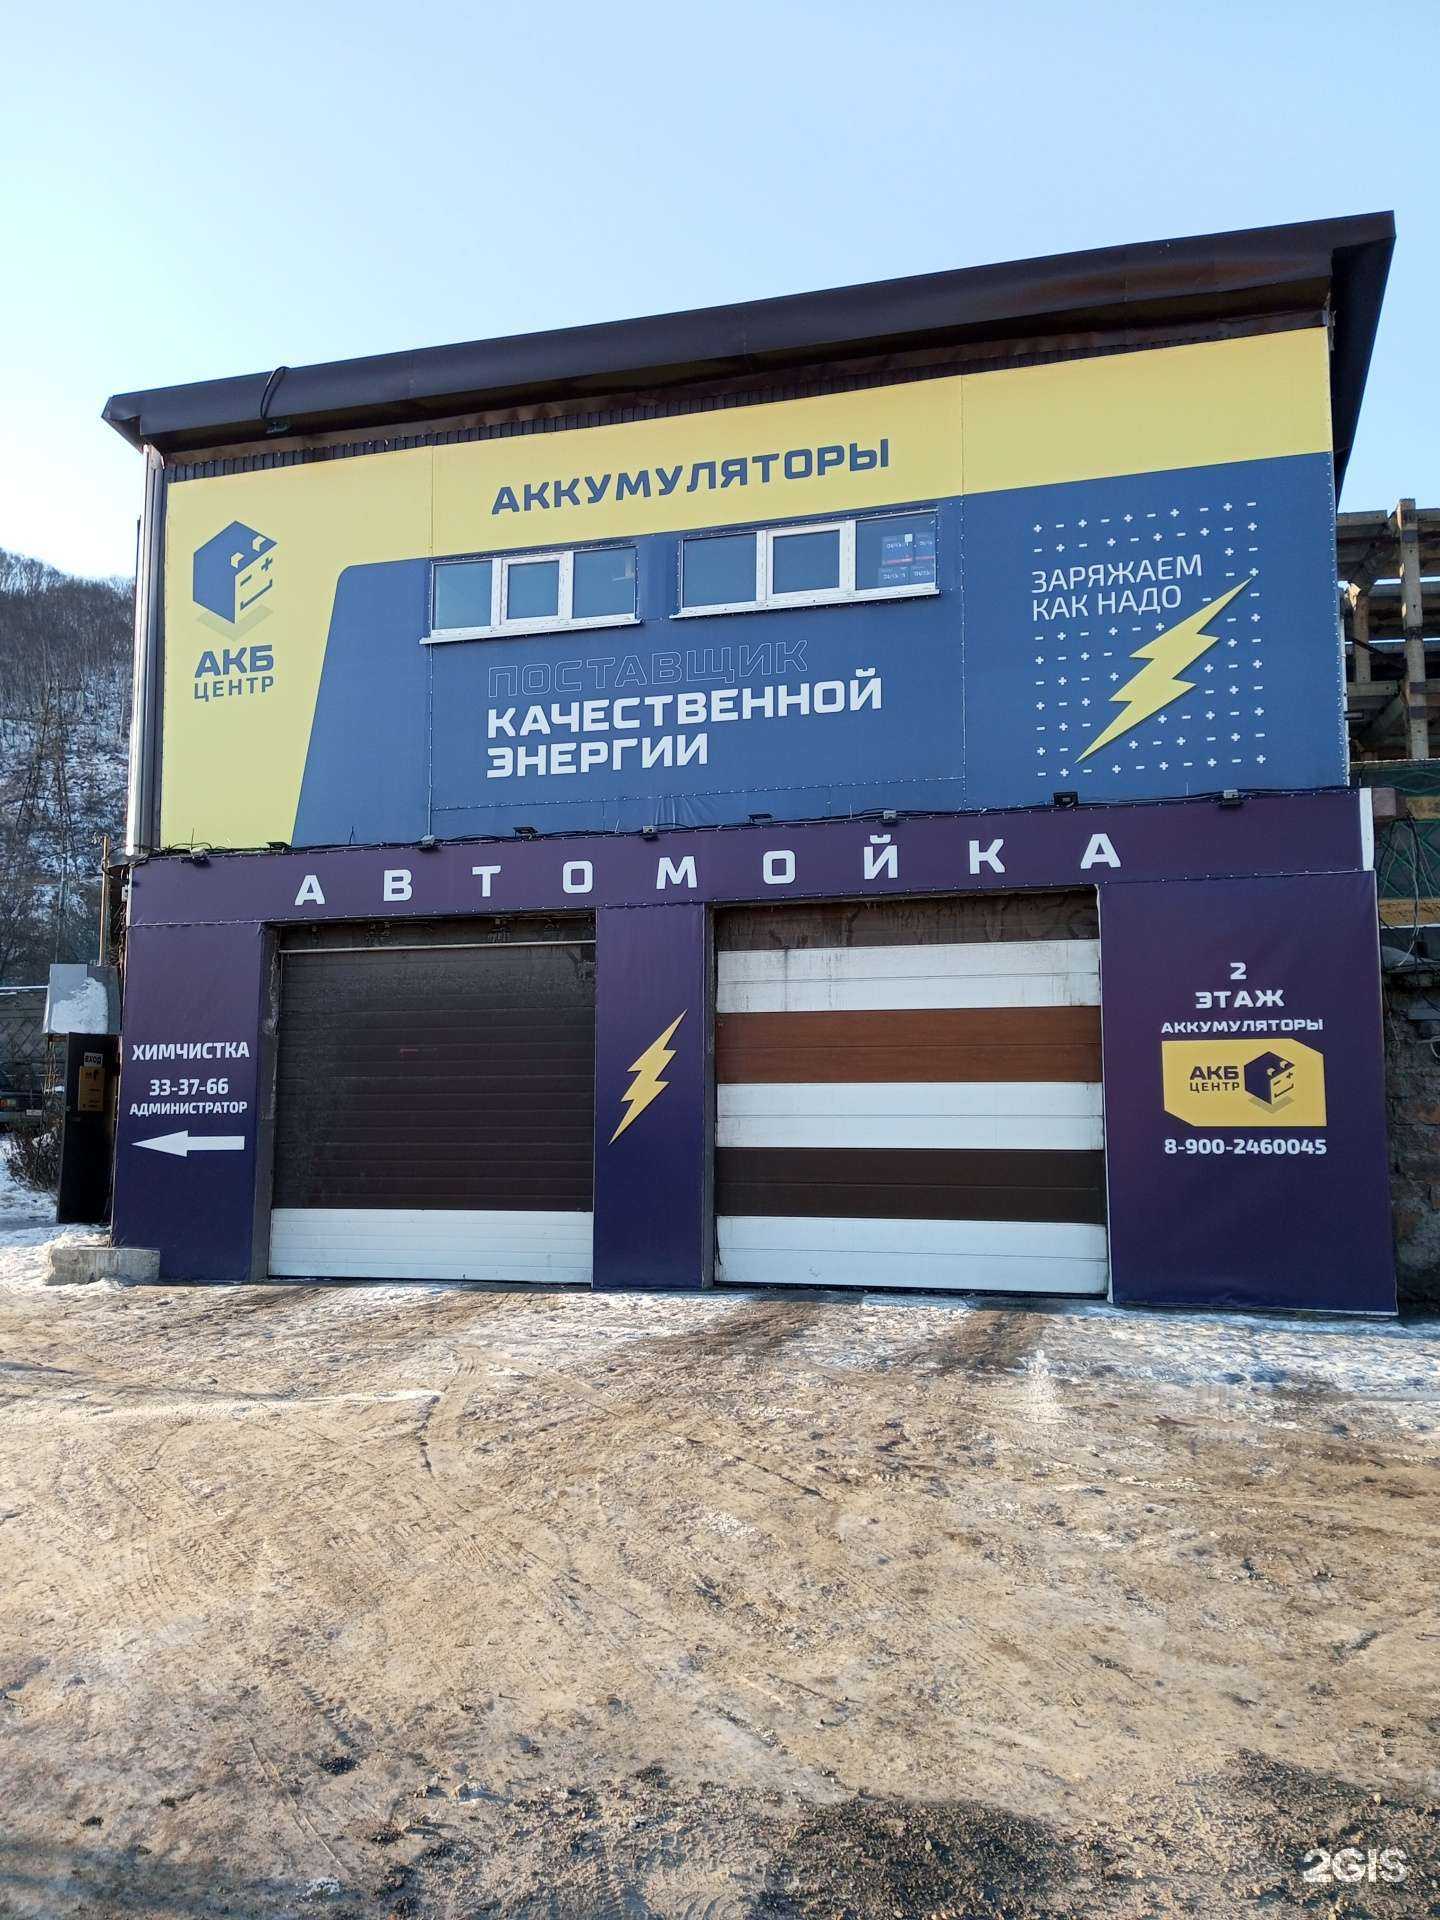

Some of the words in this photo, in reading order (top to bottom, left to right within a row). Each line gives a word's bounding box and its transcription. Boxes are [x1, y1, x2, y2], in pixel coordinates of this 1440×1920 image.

[491, 438, 889, 515] АККУМУЛЯТОРЫ
[1031, 554, 1203, 594] ЗАРЯЖАЕМ
[1032, 596, 1089, 622] КАК
[1098, 585, 1182, 616] НАДО
[194, 644, 274, 678] АКБ
[488, 640, 808, 698] ПОСТАВЩИК
[194, 676, 274, 702] ЦЕНТР
[487, 667, 882, 739] КАЧЕСТВЕННОЙ
[486, 732, 709, 779] ЭНЕРГИИ
[294, 833, 1122, 907] АВТОМОЙКА
[1229, 962, 1247, 980] 2
[1195, 989, 1285, 1009] ЭТАЖ
[1161, 1018, 1324, 1034] АККУМУЛЯТОРЫ
[131, 1041, 250, 1061] ХИМЧИСТКА
[1189, 1065, 1240, 1081] АКБ
[149, 1078, 229, 1096] 33-37-66
[1189, 1081, 1240, 1093] ЦЕНТР
[129, 1101, 248, 1117] АДМИНИСТРАТОР
[1164, 1138, 1327, 1155] 8-900-2460045
